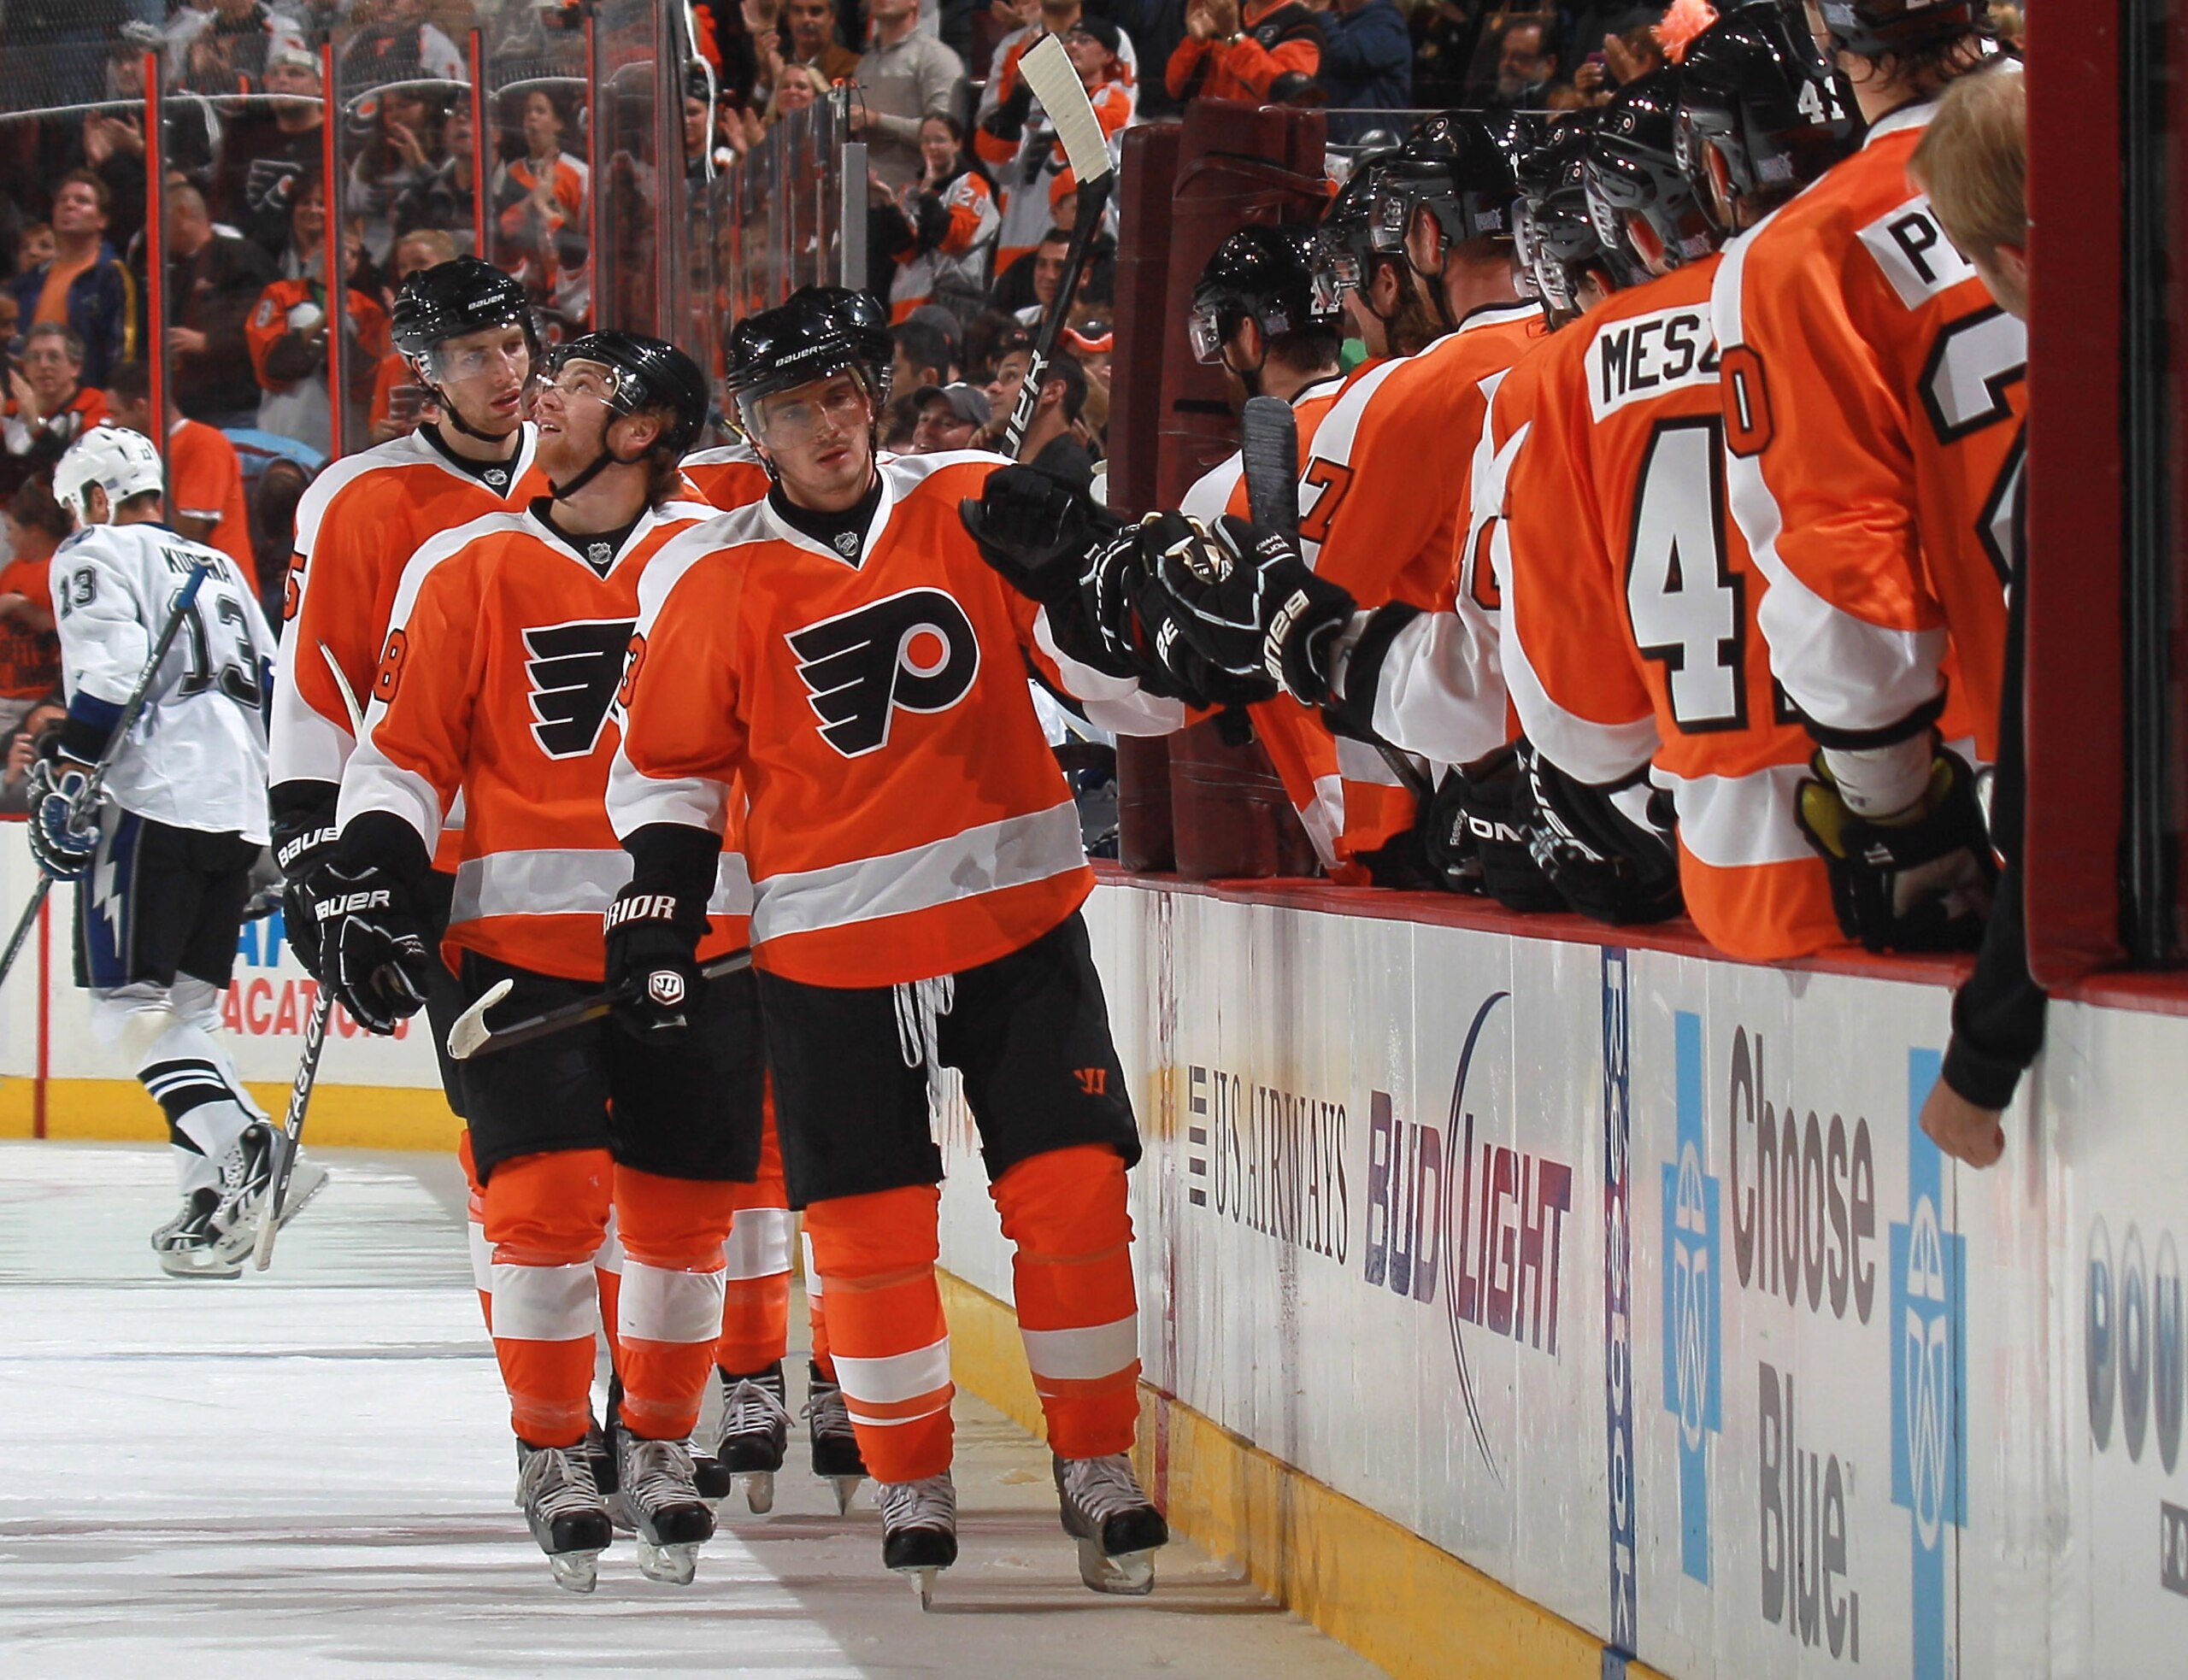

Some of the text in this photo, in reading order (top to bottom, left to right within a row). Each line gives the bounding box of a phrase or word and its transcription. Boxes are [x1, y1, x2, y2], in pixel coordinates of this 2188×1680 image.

[1797, 75, 1845, 125] 41
[468, 293, 505, 311] BAUER
[775, 345, 818, 367] BAUER
[60, 565, 97, 621] 13
[168, 587, 263, 710] 13
[278, 826, 340, 869] BAUE
[285, 984, 328, 1140] EASTON
[1245, 1082, 1349, 1266] AIRWAYS
[1729, 1024, 1875, 1326] Choose
[1364, 1089, 1444, 1306] BUD
[1456, 1112, 1573, 1357] LIGHT
